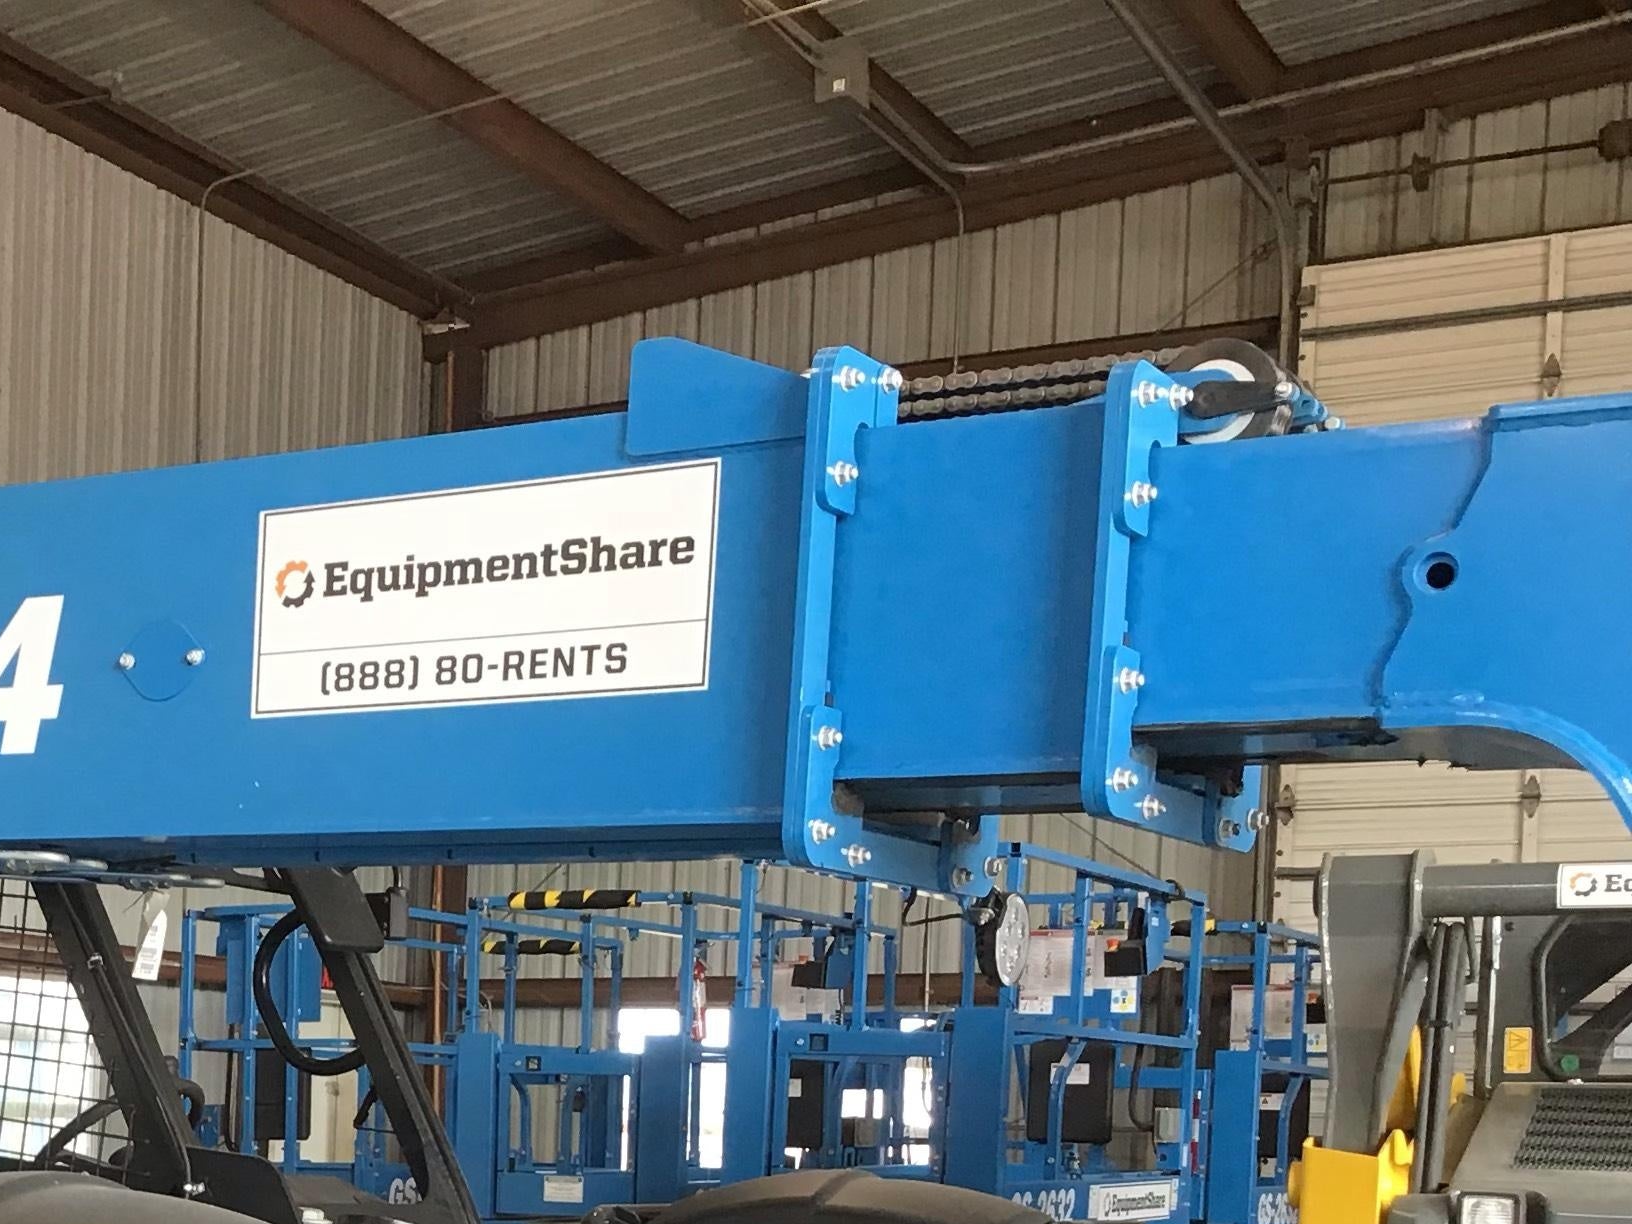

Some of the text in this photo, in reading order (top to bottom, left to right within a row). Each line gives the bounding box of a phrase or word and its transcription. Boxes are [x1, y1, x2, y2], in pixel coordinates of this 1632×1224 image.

[322, 535, 695, 603] EquipmentShare
[321, 642, 629, 695] (888) 80-RENTS
